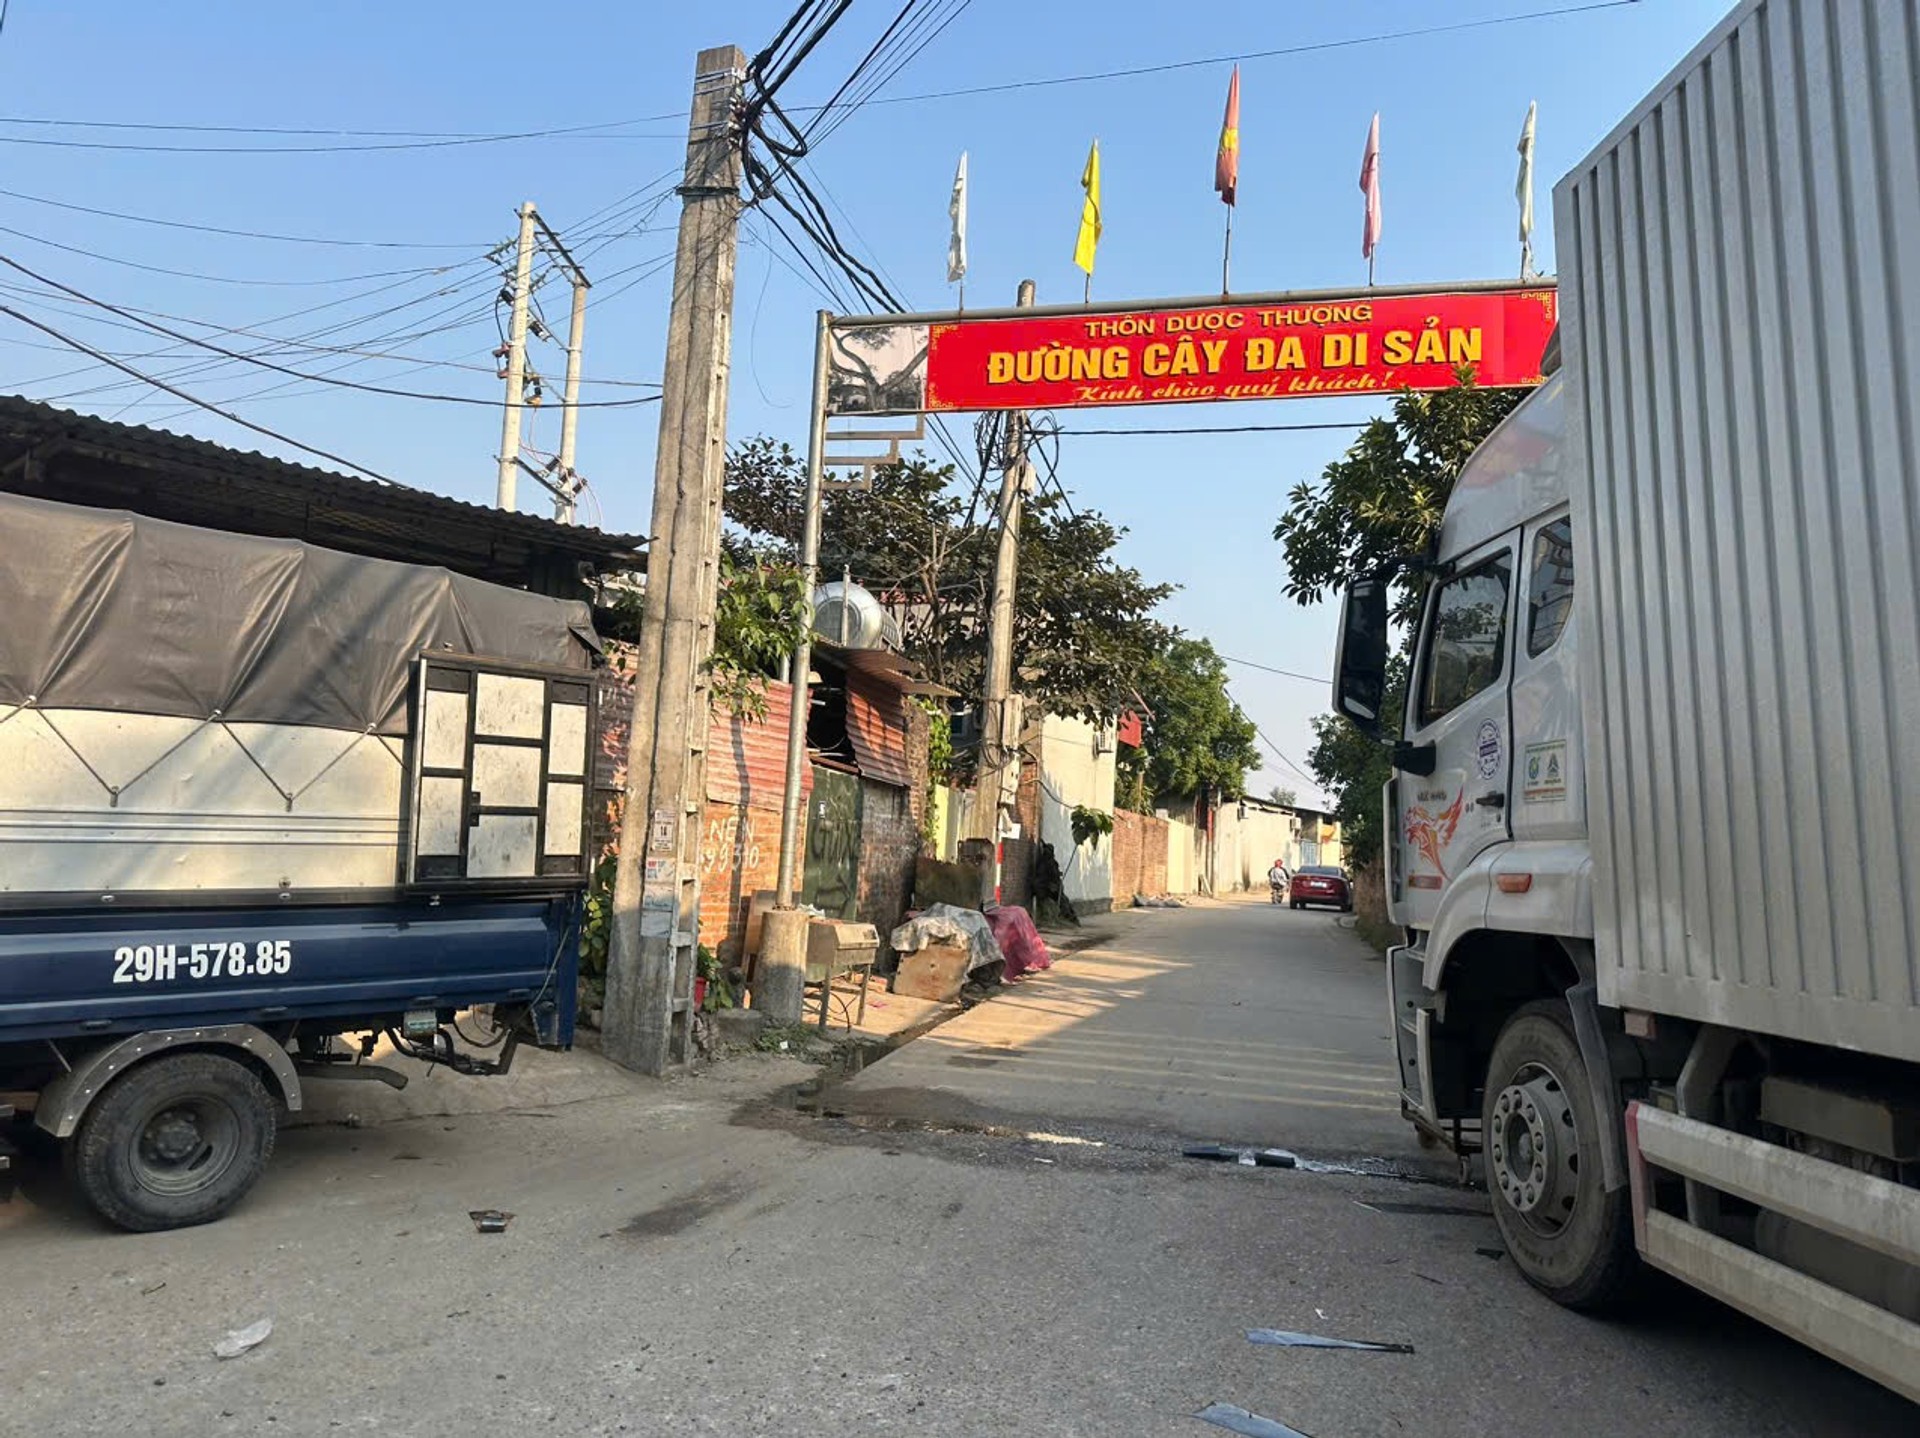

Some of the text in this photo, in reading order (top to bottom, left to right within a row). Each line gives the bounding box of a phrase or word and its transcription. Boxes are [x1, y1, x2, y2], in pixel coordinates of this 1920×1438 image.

[1085, 304, 1373, 338] THÔN DƯỢC THƯỢNG
[987, 315, 1482, 384] ĐƯỜNG CÂY ĐA DI SẢN
[1074, 371, 1394, 402] Kính chào quý khách!
[113, 940, 292, 983] 29H-578.85
